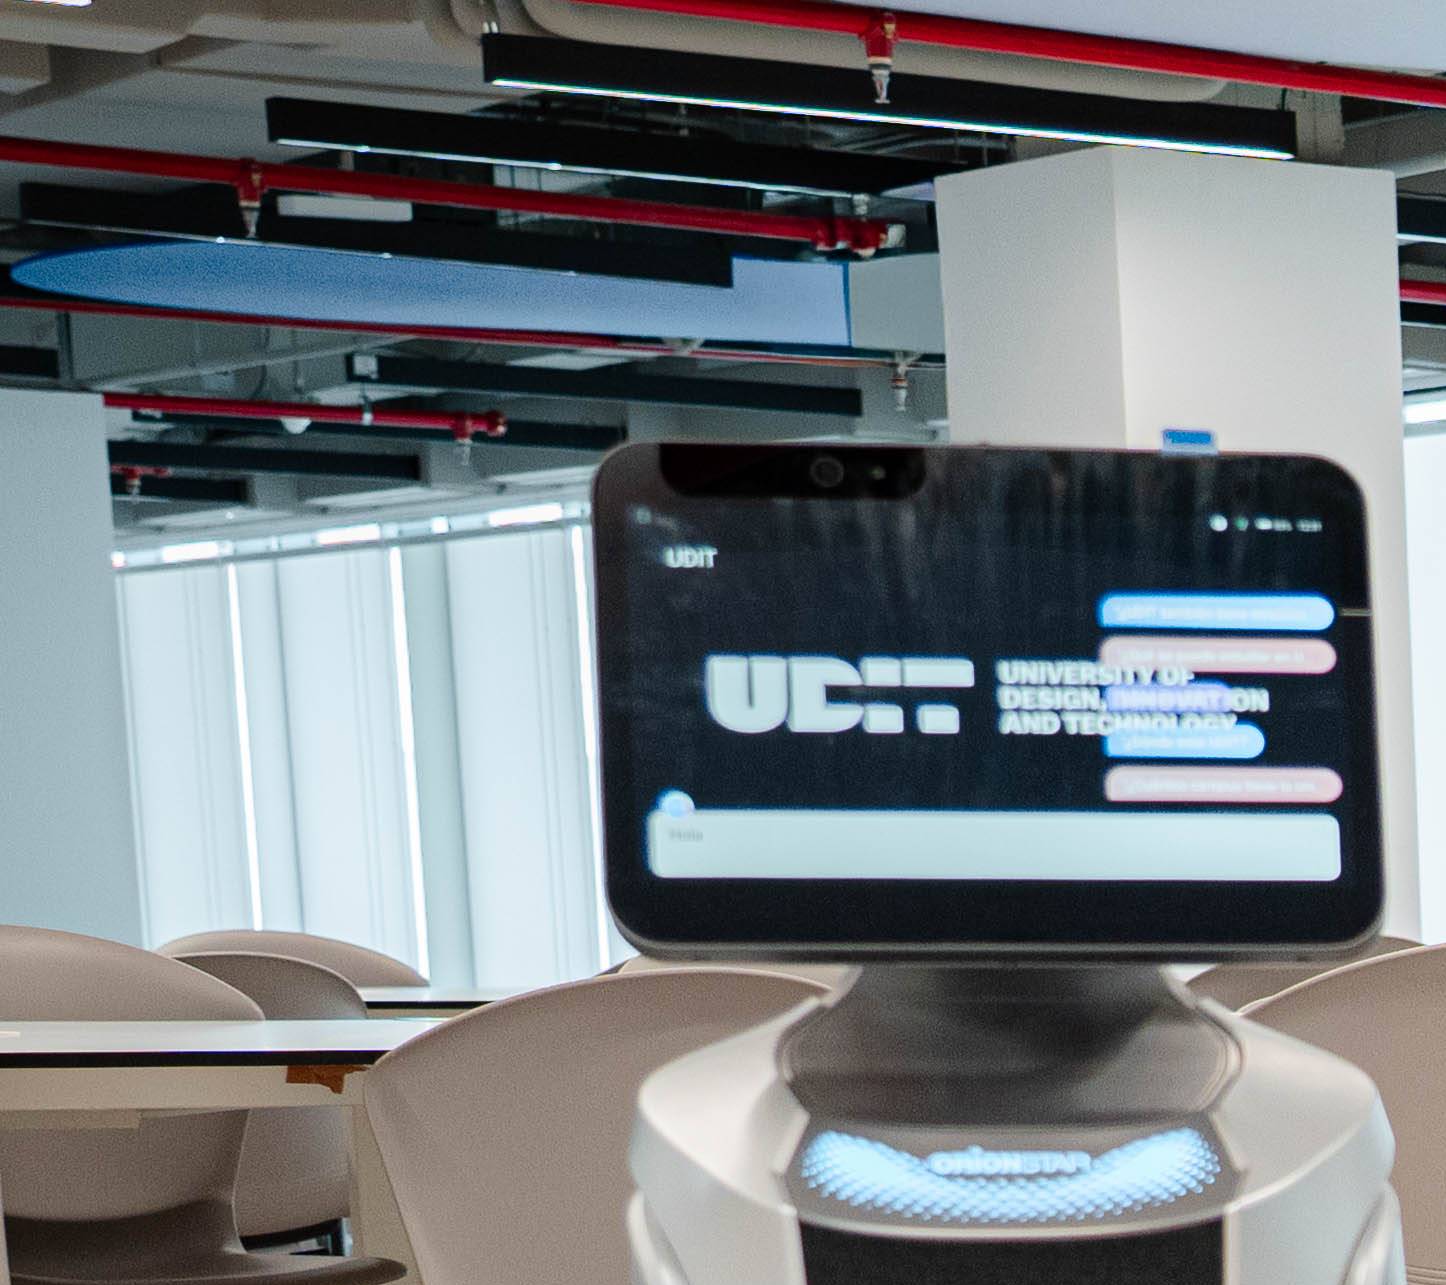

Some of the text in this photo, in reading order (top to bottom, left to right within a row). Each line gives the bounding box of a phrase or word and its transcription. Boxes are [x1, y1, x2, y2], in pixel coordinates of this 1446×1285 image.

[662, 547, 718, 568] UDIT
[997, 660, 1194, 686] UNIVERSITY OF
[704, 653, 975, 734] UDIT
[1000, 712, 1237, 735] AND TECHNOLOGY
